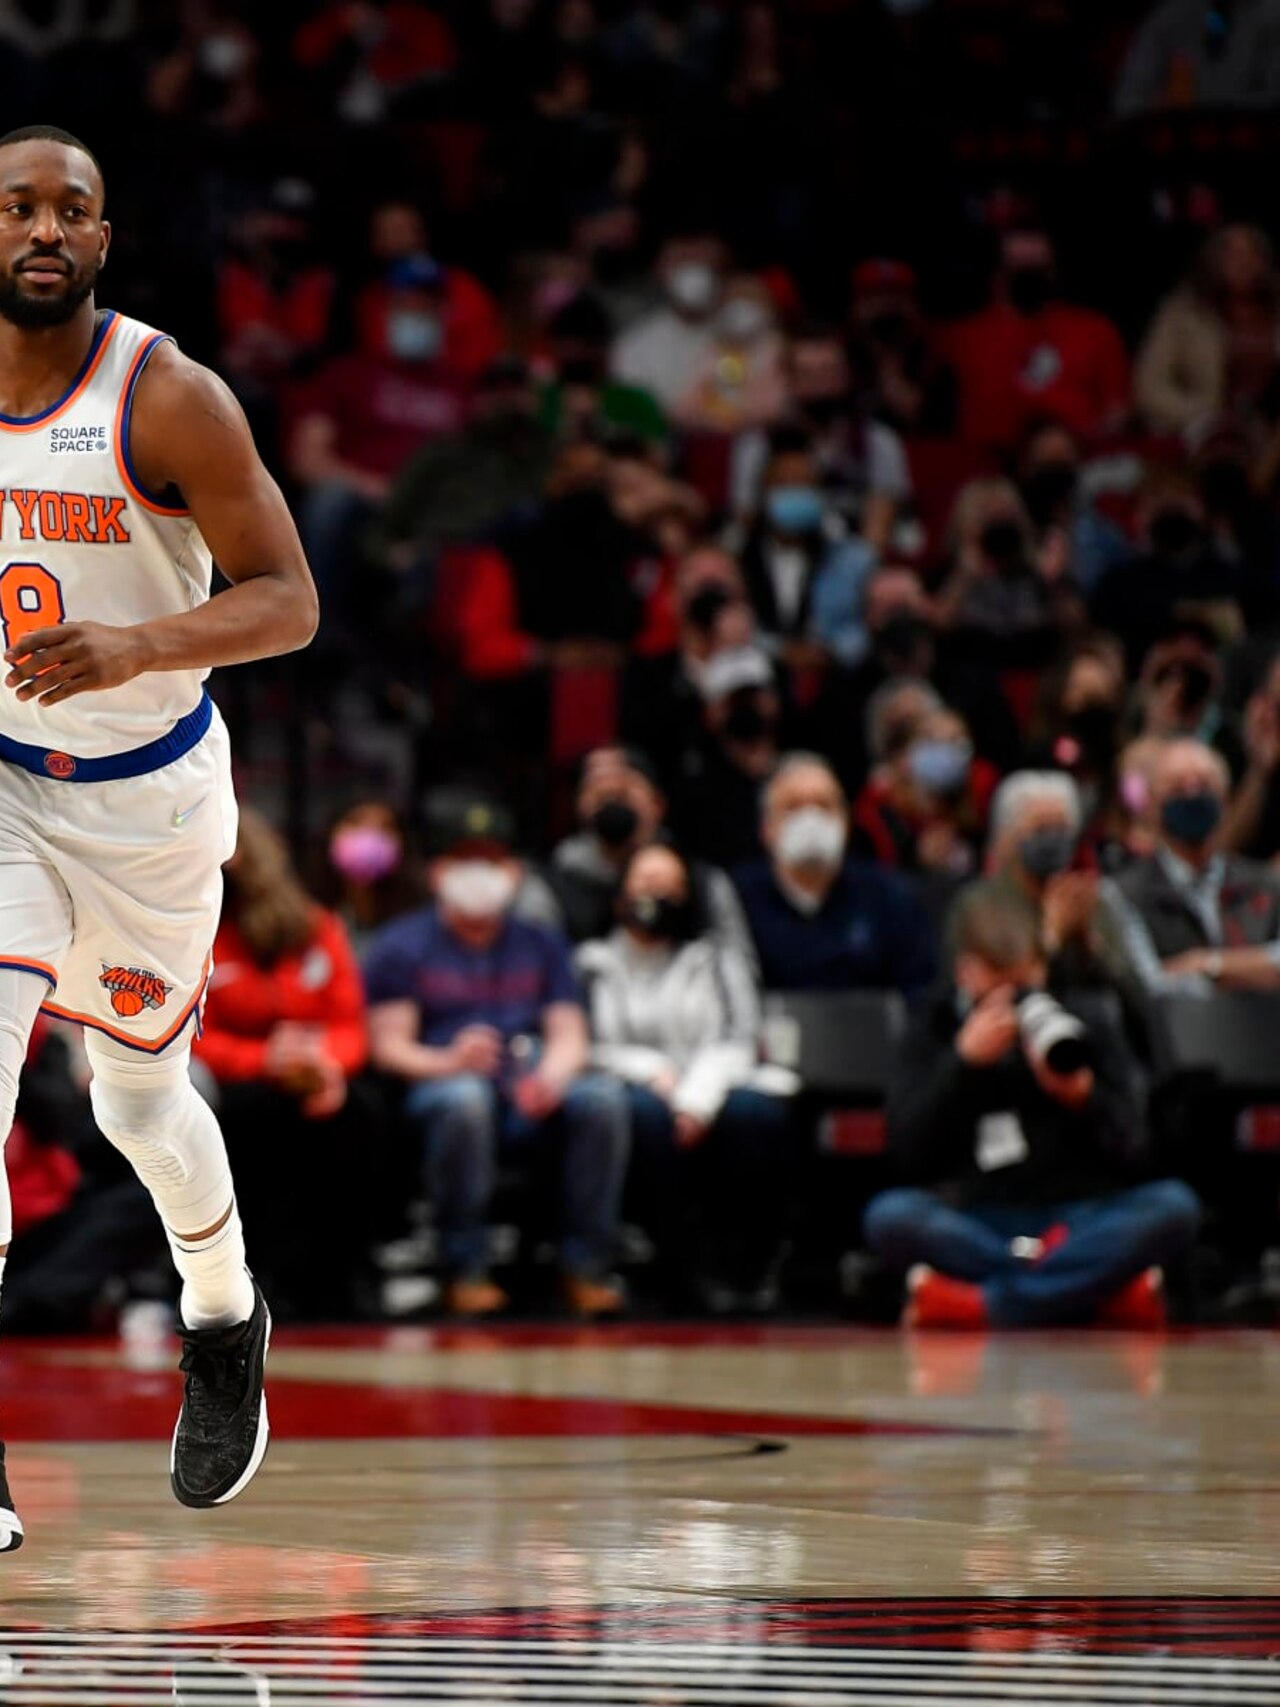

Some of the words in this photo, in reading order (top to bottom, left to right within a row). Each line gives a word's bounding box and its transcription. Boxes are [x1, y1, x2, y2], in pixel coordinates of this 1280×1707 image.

[50, 426, 106, 439] SQUARE
[50, 440, 94, 453] SPACE
[10, 490, 131, 543] YORK
[99, 966, 166, 1006] KNICKS
